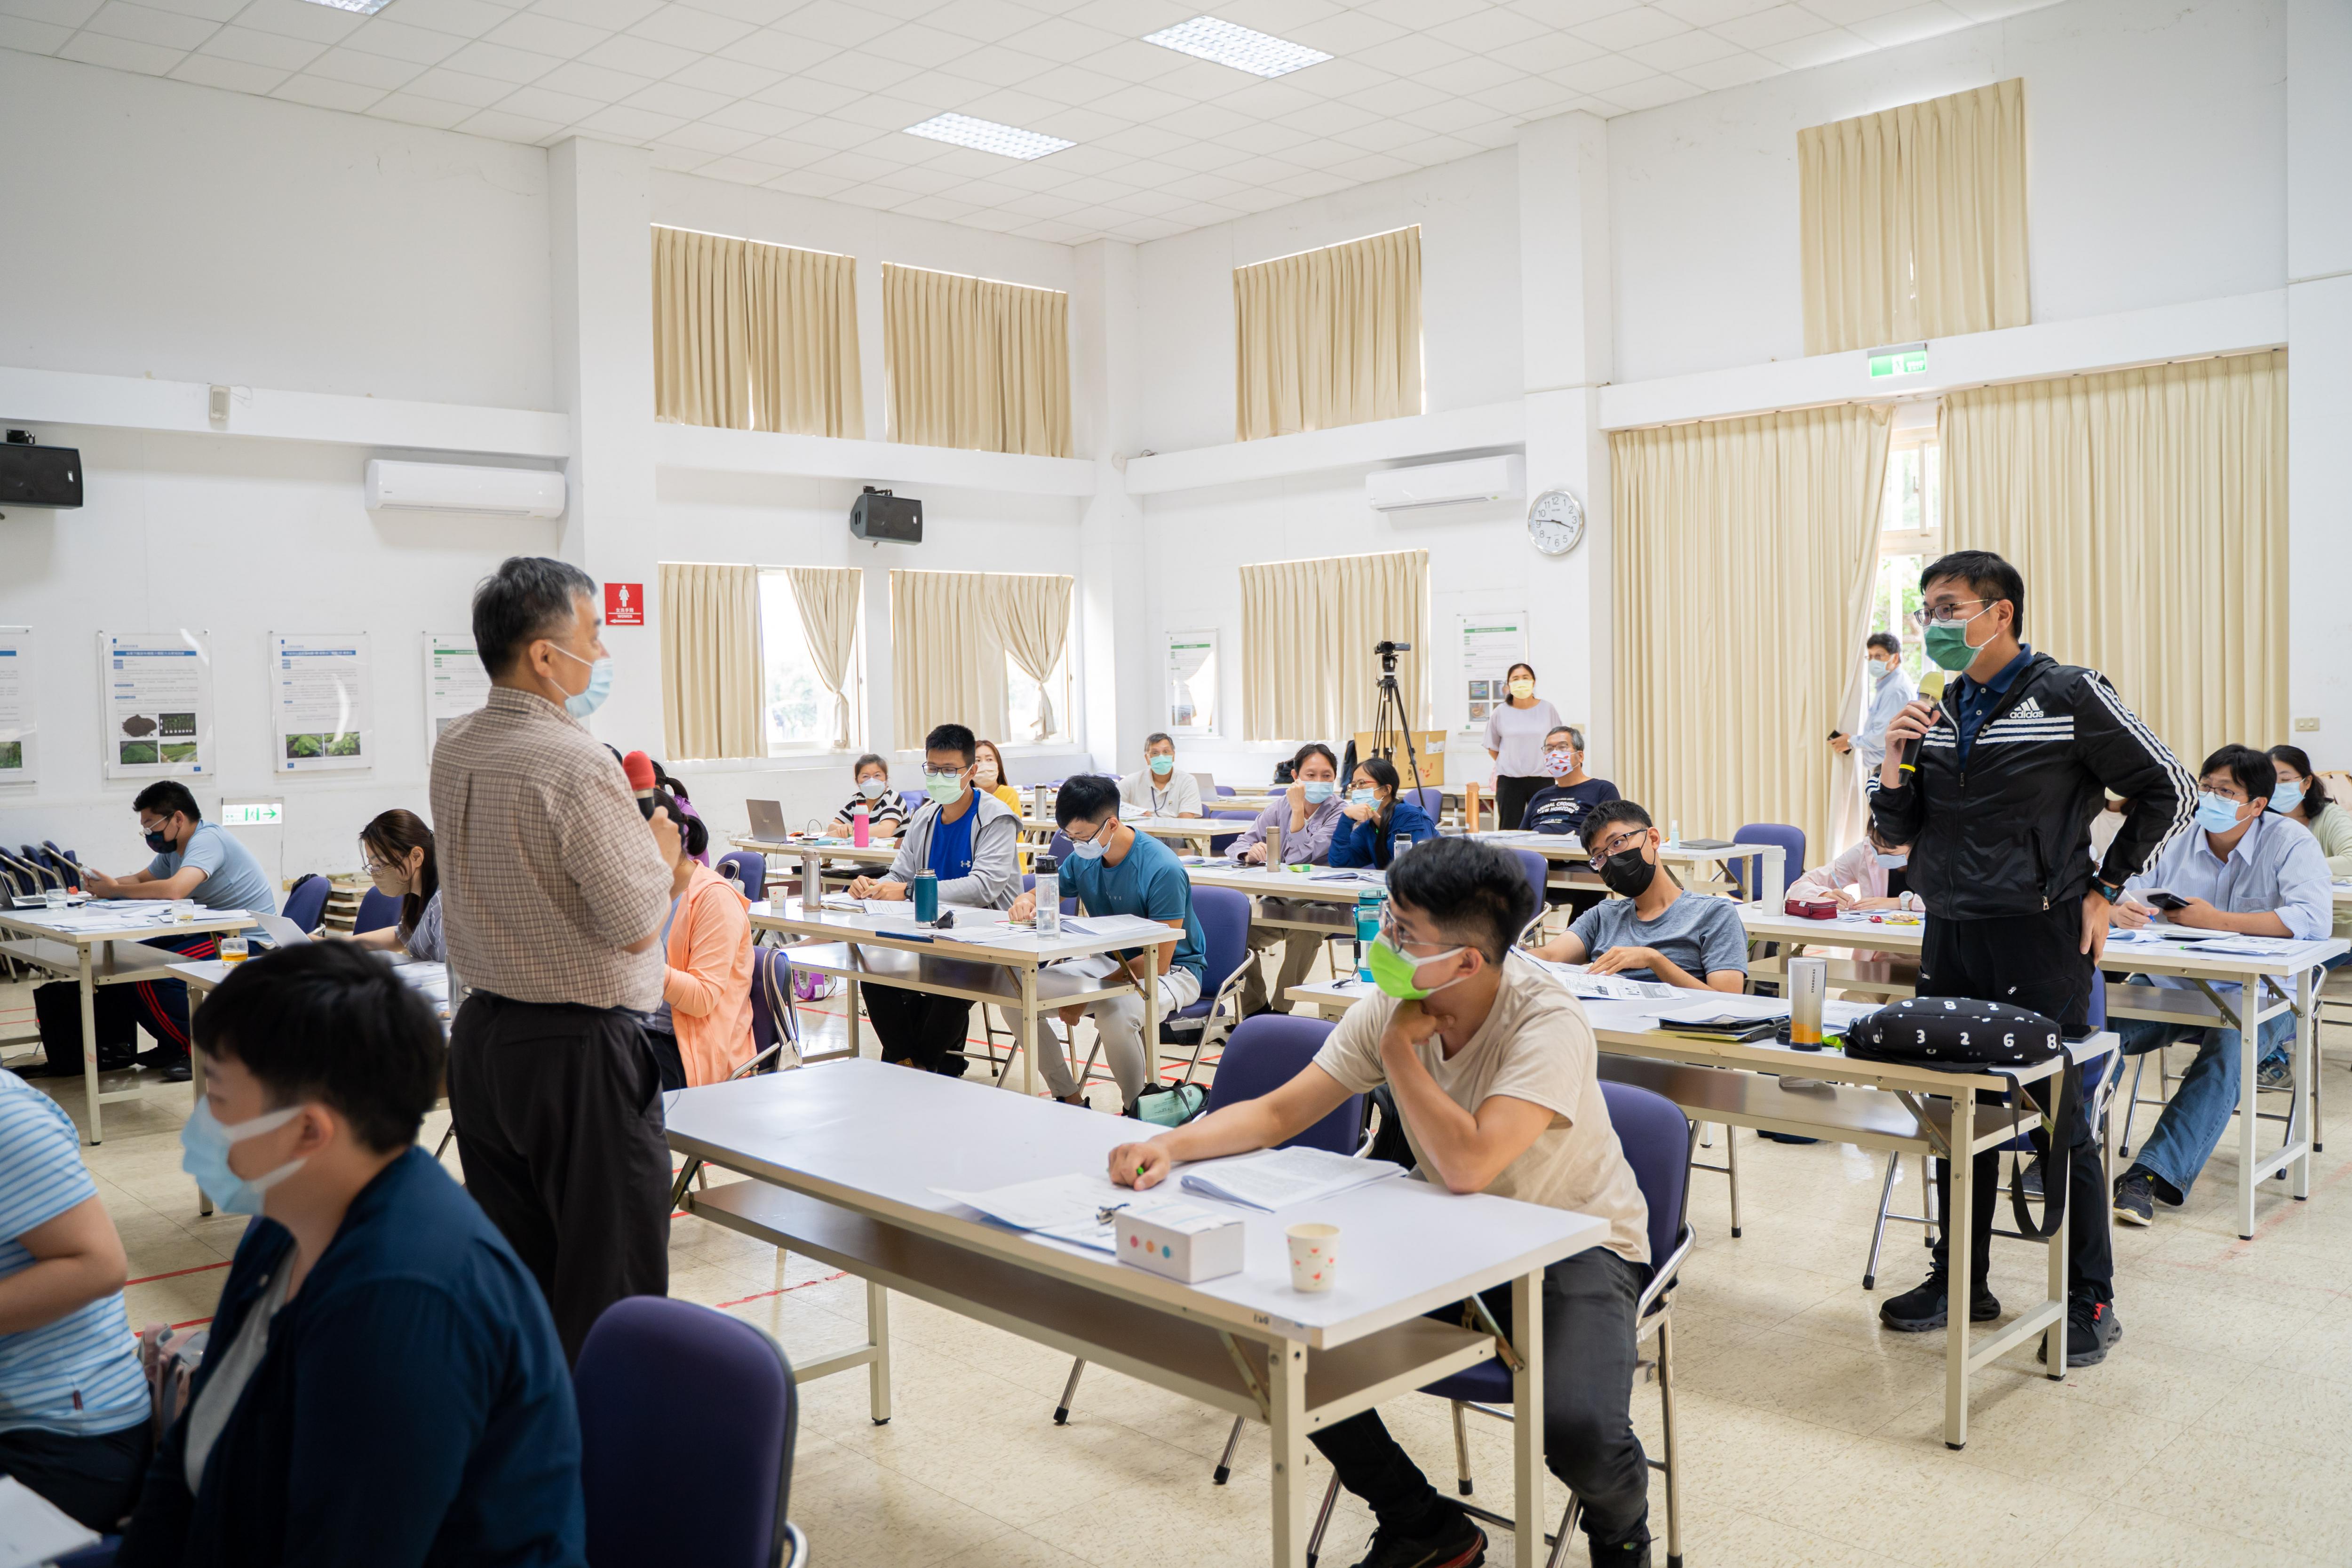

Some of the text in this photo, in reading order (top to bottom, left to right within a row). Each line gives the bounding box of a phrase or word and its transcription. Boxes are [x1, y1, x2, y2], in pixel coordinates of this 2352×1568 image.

[2010, 710, 2044, 718] adidas
[1556, 801, 1580, 811] CROSSING
[1944, 1001, 1957, 1010] 8
[1916, 1029, 2057, 1049] 3 2 6 8
